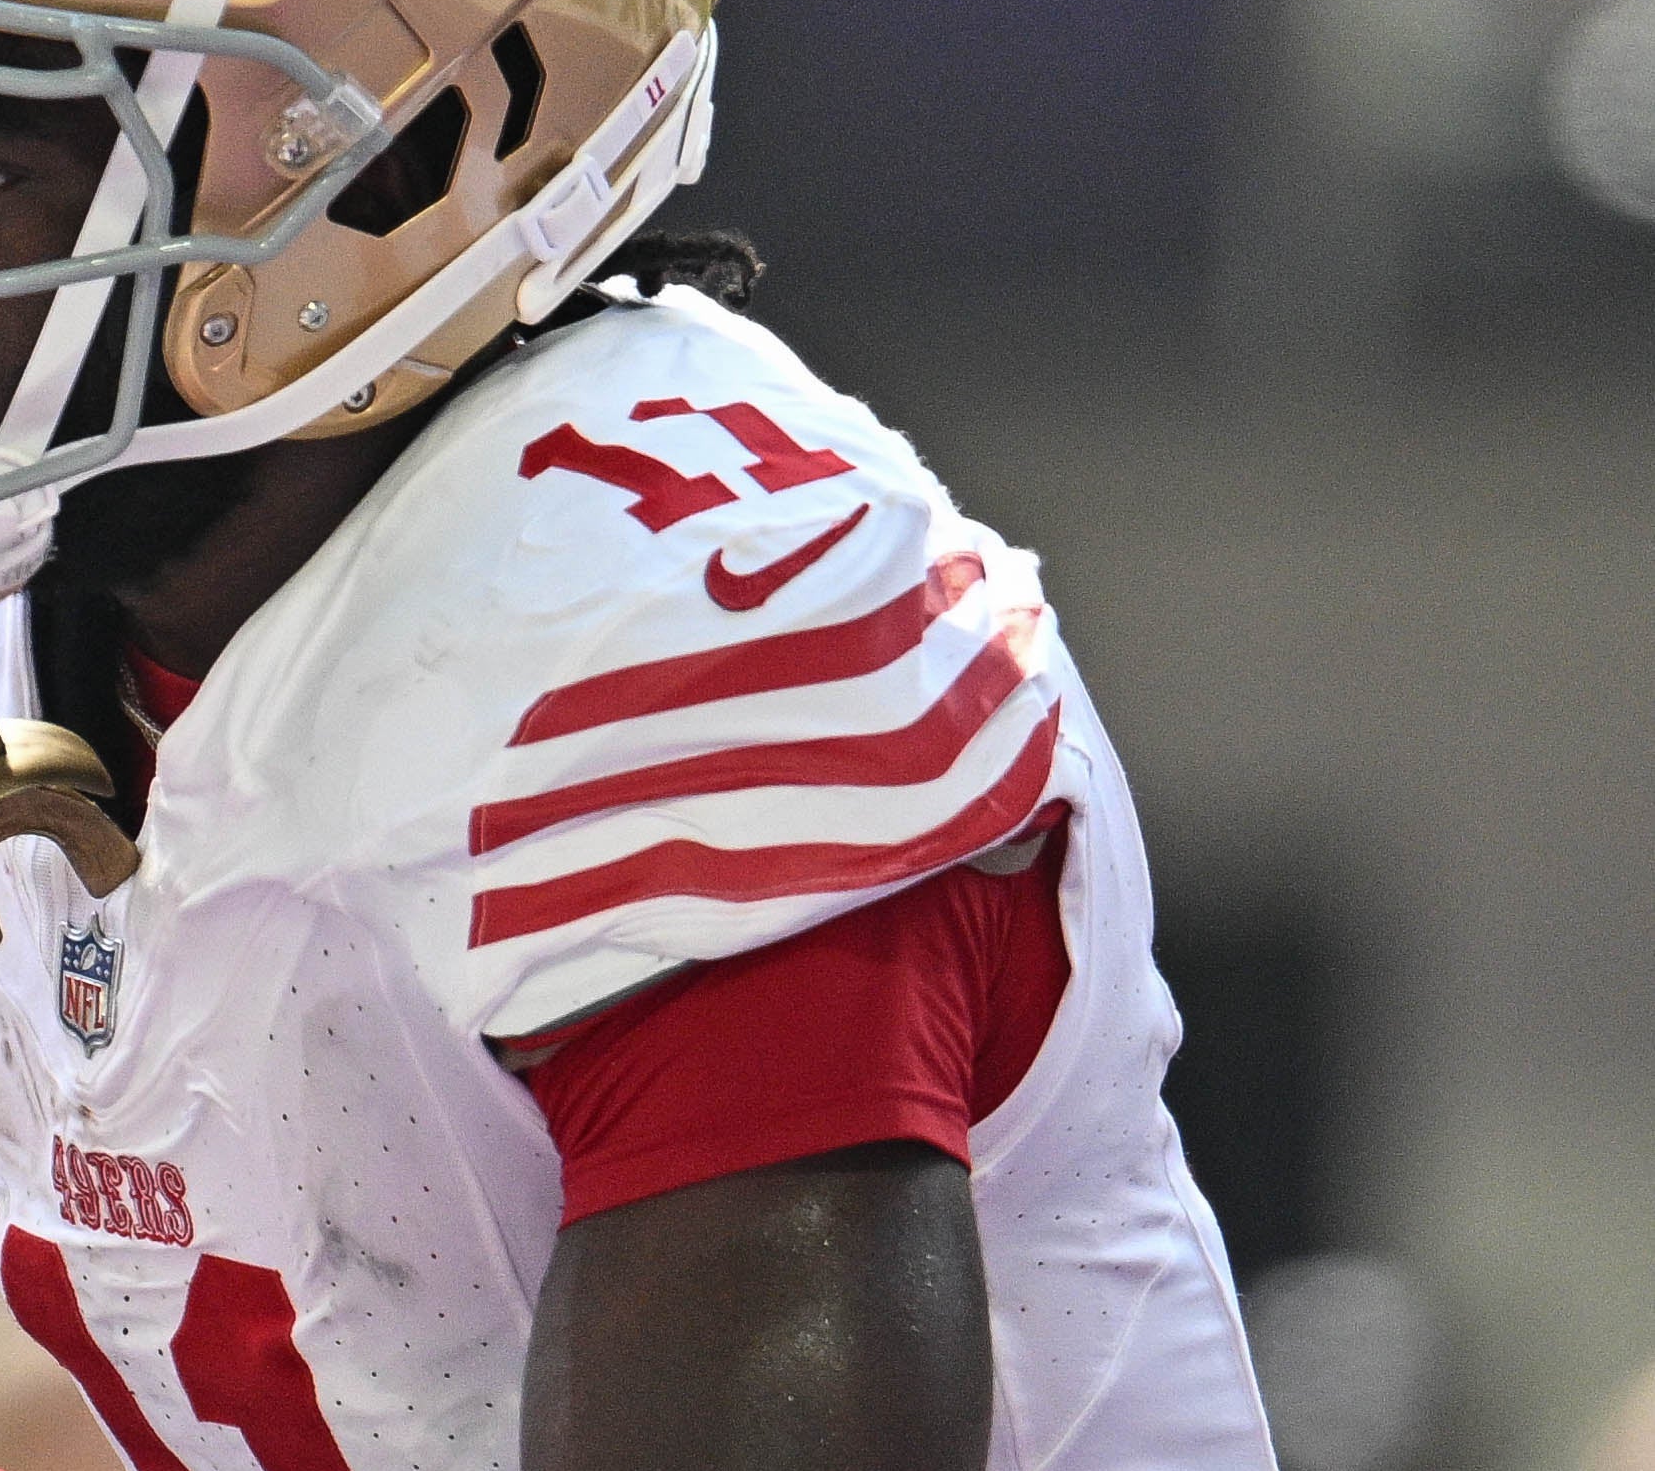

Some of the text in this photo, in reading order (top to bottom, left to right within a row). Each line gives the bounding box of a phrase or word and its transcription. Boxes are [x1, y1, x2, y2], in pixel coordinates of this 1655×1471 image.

[645, 76, 665, 108] 11
[518, 397, 858, 533] 11
[63, 975, 105, 1033] NFL
[52, 1134, 194, 1248] 49ERS
